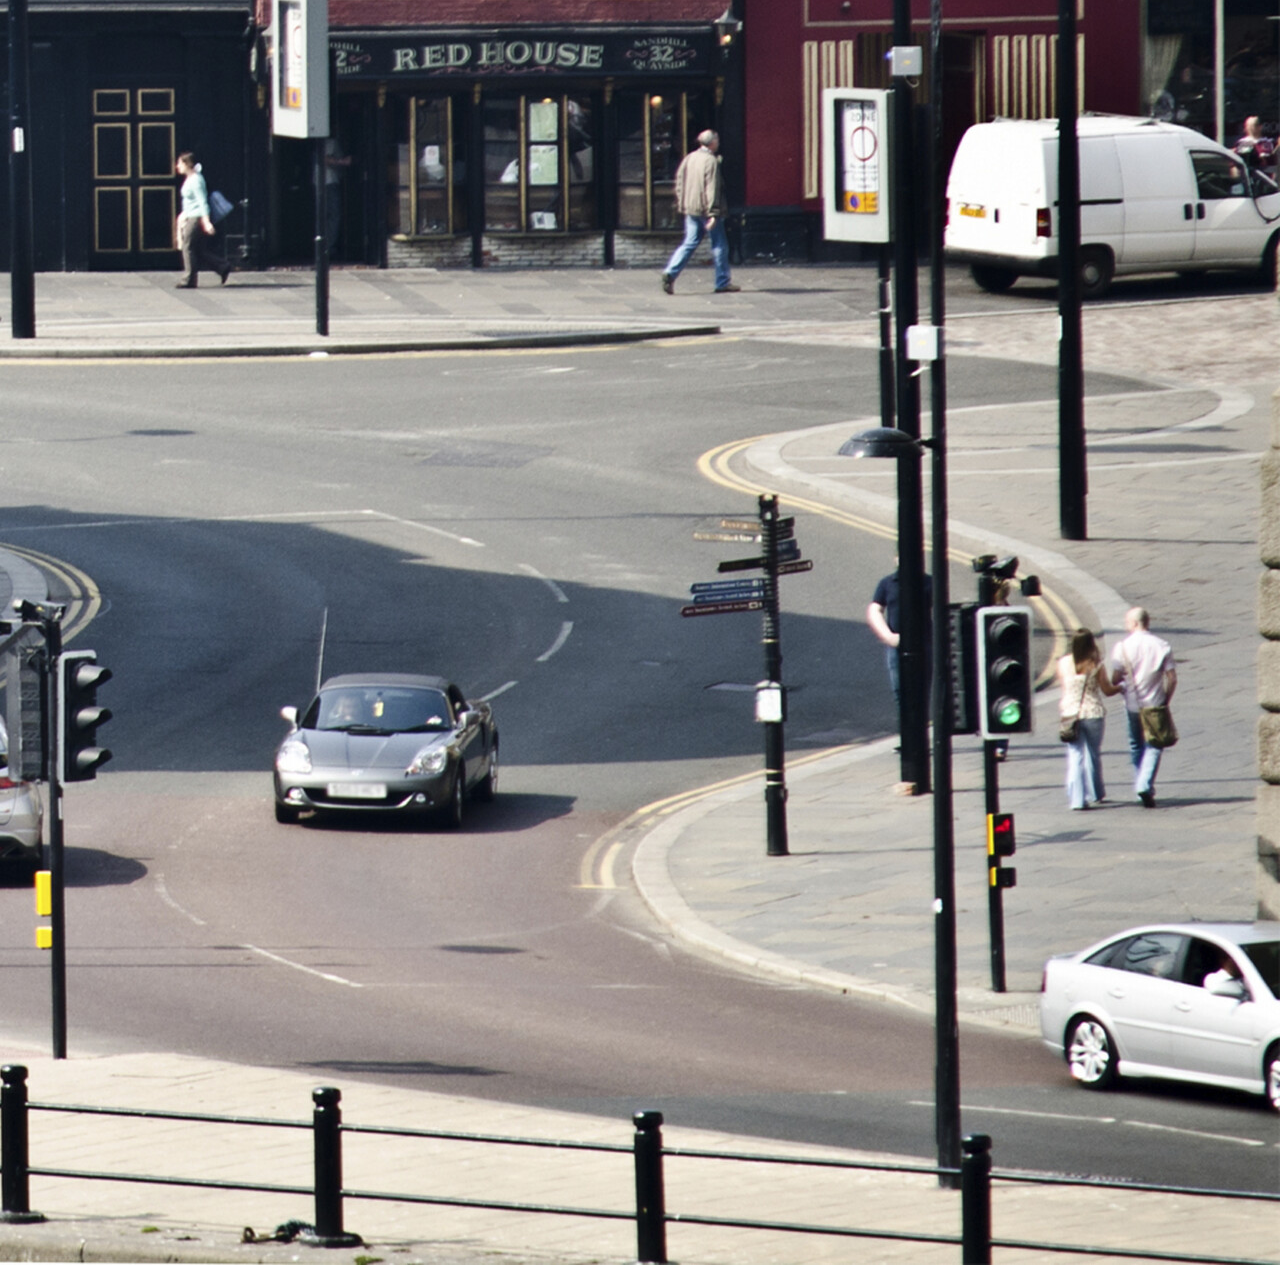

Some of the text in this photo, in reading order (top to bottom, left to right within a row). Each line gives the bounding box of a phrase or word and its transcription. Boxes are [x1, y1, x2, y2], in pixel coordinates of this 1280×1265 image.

[633, 37, 688, 48] SANDHILL
[392, 41, 604, 71] RED HOUSE
[650, 45, 674, 62] 32
[632, 59, 687, 70] QUAYSIDE
